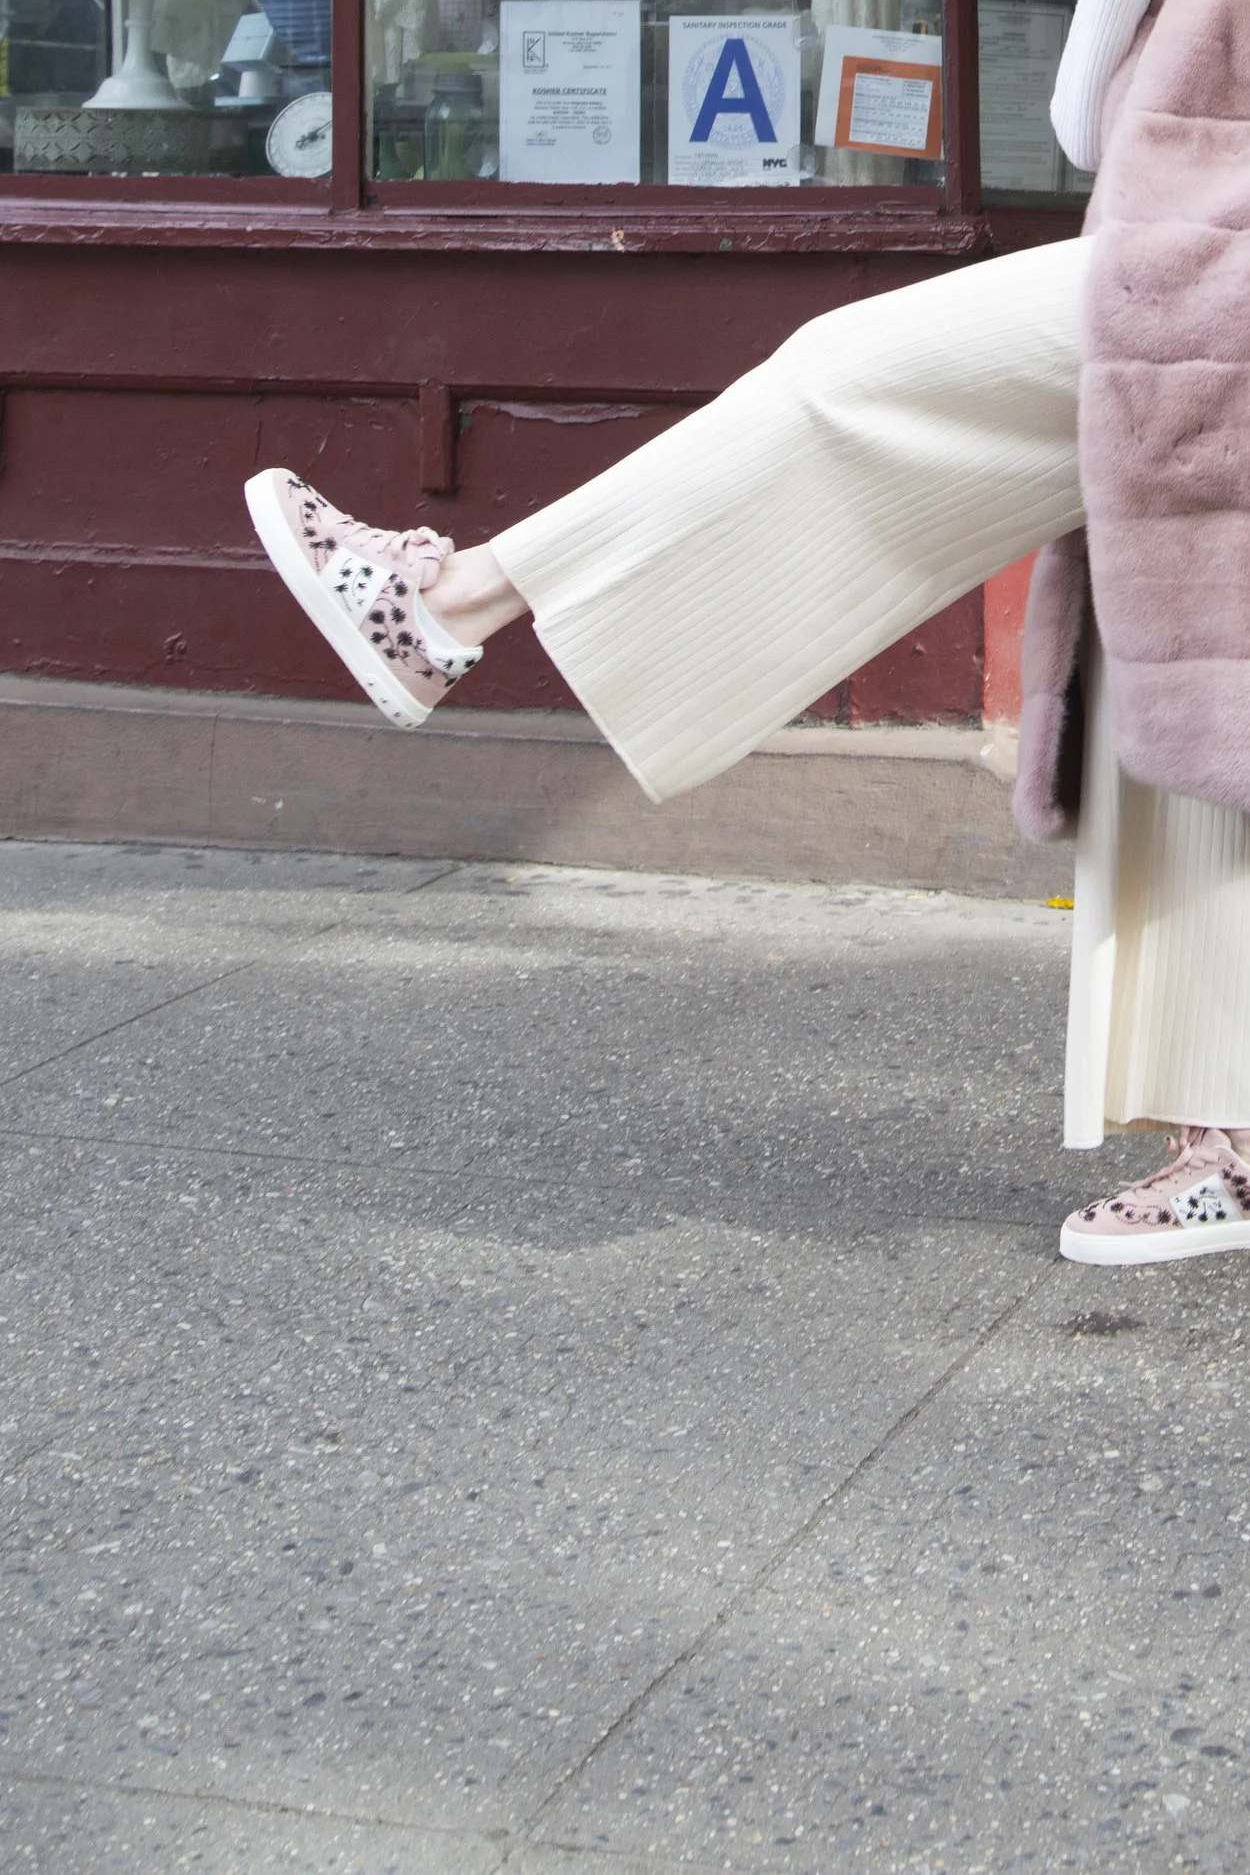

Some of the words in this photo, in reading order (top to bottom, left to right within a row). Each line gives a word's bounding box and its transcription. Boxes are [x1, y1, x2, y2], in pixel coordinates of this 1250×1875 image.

[682, 20, 718, 30] SANITARY
[718, 20, 761, 30] INSPECTION
[762, 20, 788, 30] GRADE
[532, 87, 561, 95] KOSHER
[562, 87, 608, 95] CERTIFICATE
[688, 38, 778, 143] A
[762, 157, 788, 168] NYC
